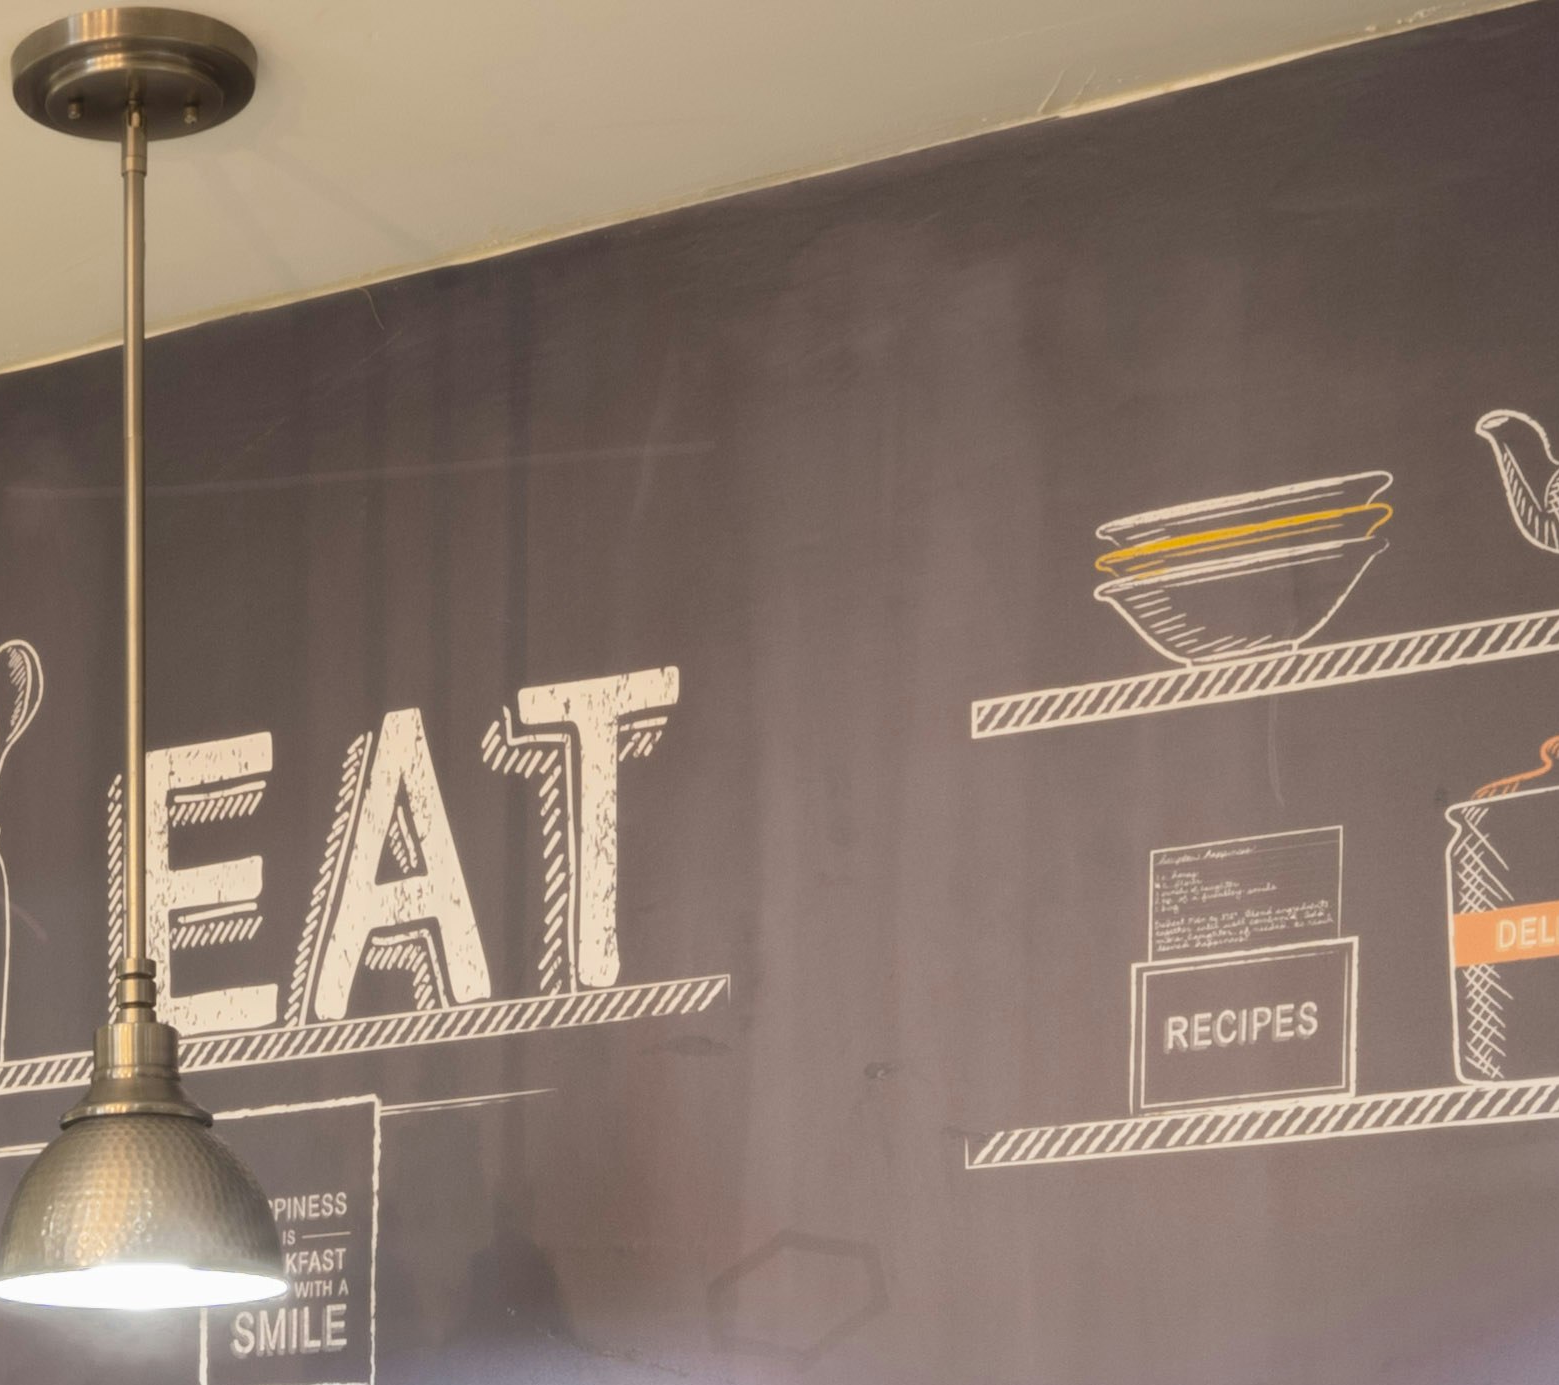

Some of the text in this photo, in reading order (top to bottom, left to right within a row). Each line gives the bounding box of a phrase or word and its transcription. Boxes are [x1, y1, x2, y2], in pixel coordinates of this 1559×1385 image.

[141, 665, 680, 1036] EAT
[1166, 1001, 1319, 1051] RECIPES
[268, 1192, 348, 1222] PINESS
[283, 1230, 296, 1245] IS
[285, 1248, 347, 1274] KFAST
[294, 1279, 349, 1298] WITH A
[232, 1303, 348, 1356] SMILE
